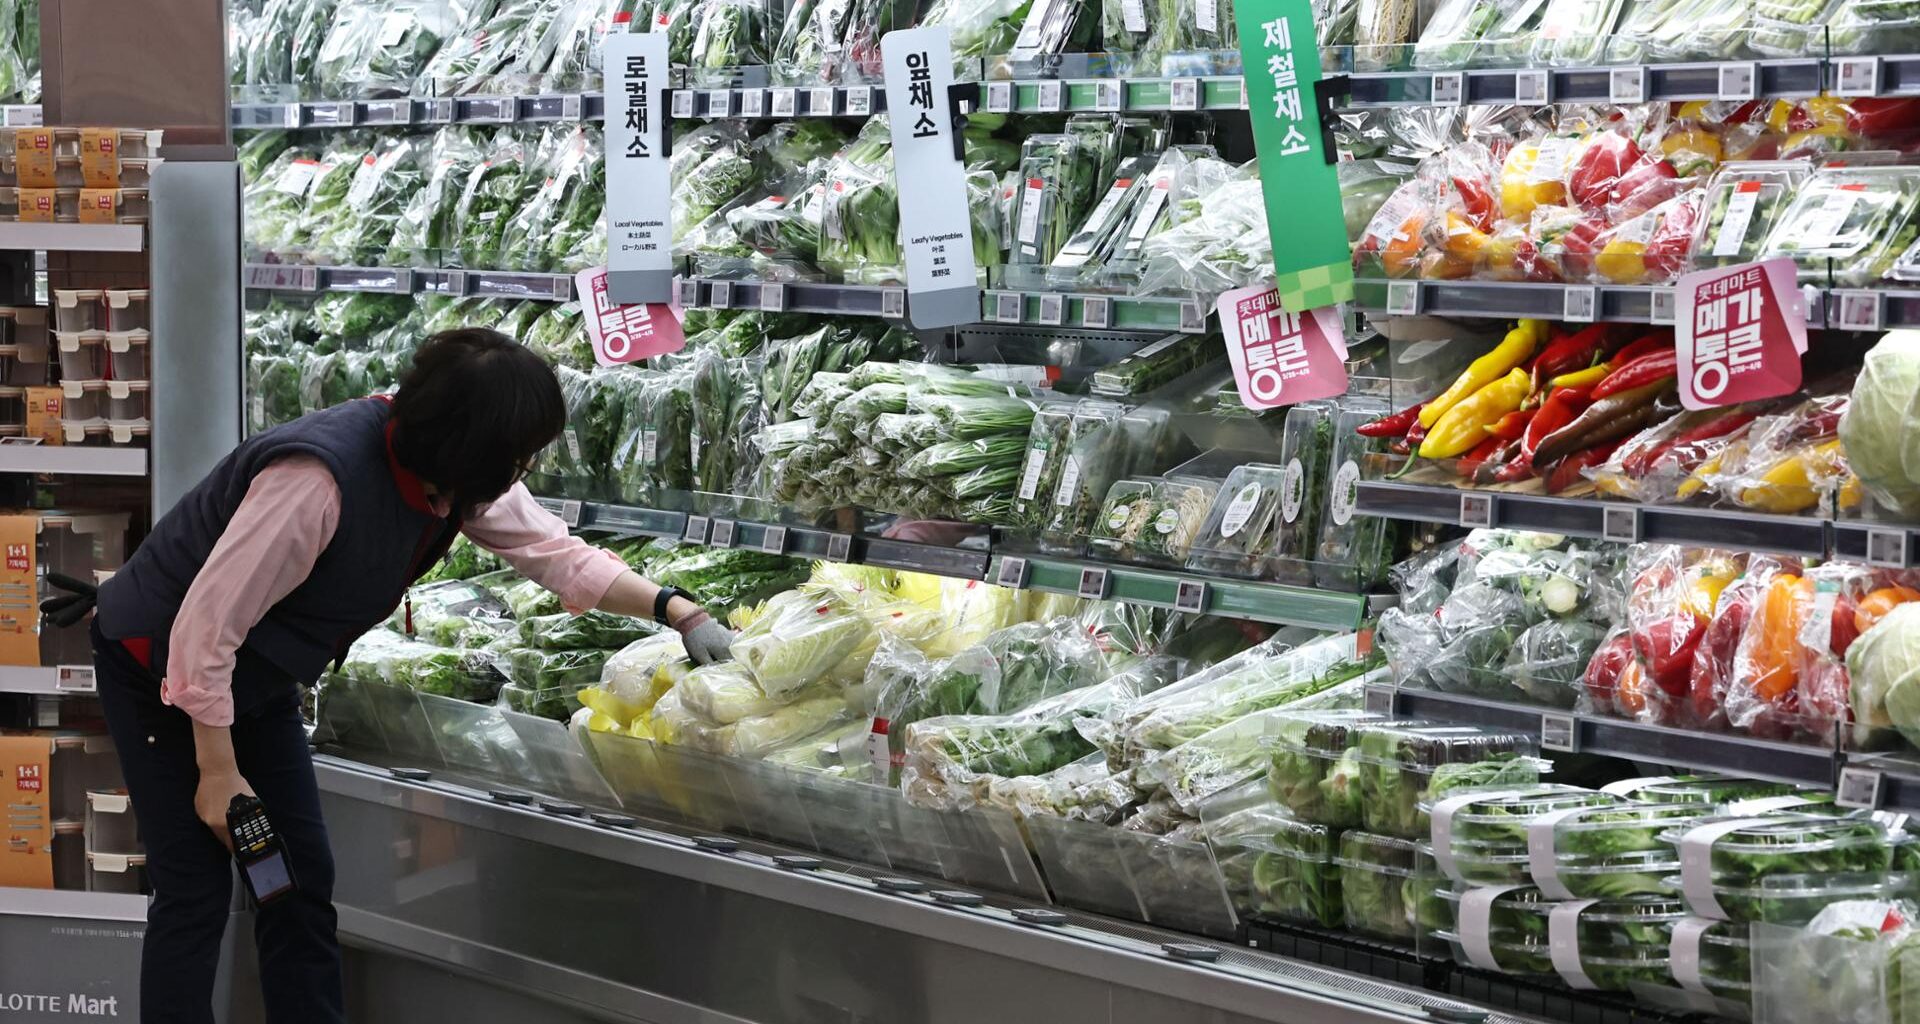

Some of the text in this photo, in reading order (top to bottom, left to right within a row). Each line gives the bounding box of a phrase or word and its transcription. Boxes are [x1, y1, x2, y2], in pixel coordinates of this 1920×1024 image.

[906, 51, 938, 138] 잎채소
[1261, 17, 1310, 156] 제철채소
[624, 56, 650, 158] 로컬채소
[614, 220, 664, 228] Local Vegetables
[911, 232, 963, 245] Leafy Vegetables
[1240, 290, 1280, 317] 롯데마
[1698, 268, 1762, 303] 롯데마트
[1242, 308, 1301, 346] 메가
[1697, 287, 1764, 336] 메가
[600, 304, 652, 359] 통큰
[1246, 334, 1310, 401] 통큰
[1693, 322, 1763, 399] 통큰
[8, 544, 27, 557] 1+1
[18, 765, 40, 778] 1+1
[0, 993, 118, 1017] LOTTE Mart
